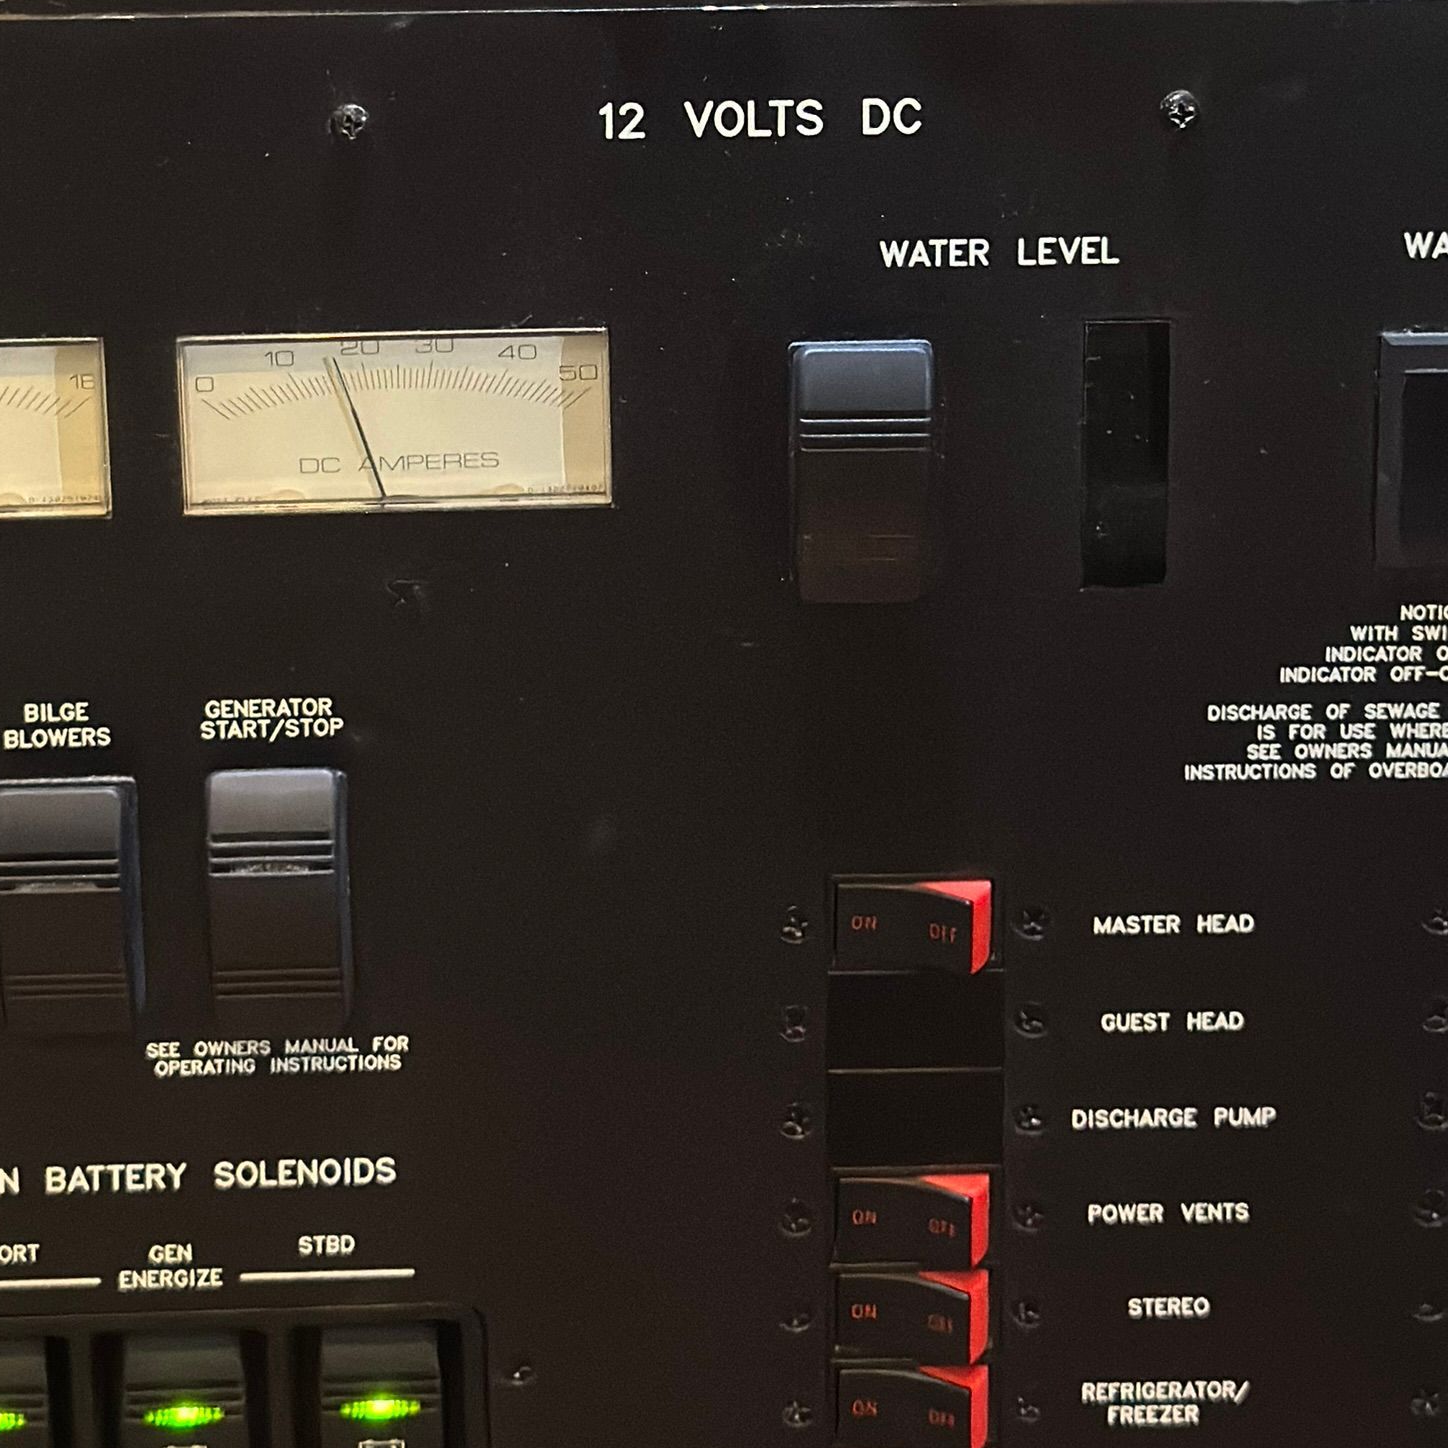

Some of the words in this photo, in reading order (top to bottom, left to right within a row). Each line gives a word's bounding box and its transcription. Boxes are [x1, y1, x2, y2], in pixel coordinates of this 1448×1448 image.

[599, 102, 645, 139] 12
[684, 99, 823, 137] VOLTS
[863, 98, 921, 135] DC
[880, 239, 989, 267] WATER
[1018, 236, 1120, 265] LEVEL
[299, 454, 340, 475] DC
[359, 451, 500, 472] AMPERES
[1350, 625, 1398, 641] WITH
[1326, 646, 1422, 662] INDICATOR
[1280, 666, 1376, 683] INDICATOR
[24, 702, 89, 722] BILGE
[205, 698, 332, 718] GENERATOR
[1208, 704, 1312, 721] DISCHARGE
[1326, 703, 1350, 720] OF
[1365, 702, 1440, 719] SEWAGE
[4, 727, 111, 749] BLOWERS
[200, 718, 344, 742] START/STOP
[1094, 915, 1180, 934] MASTER
[1197, 914, 1254, 933] HEAD
[1101, 1012, 1170, 1032] GUEST
[1187, 1011, 1244, 1031] HEAD
[146, 1042, 180, 1058] SEE
[194, 1040, 270, 1057] OWNERS
[285, 1037, 359, 1053] MANUAL
[373, 1035, 408, 1052] FOR
[154, 1058, 255, 1077] OPERATING
[271, 1054, 401, 1073] INSTRUCTIONS
[1072, 1108, 1197, 1129] DISCHARGE
[1215, 1107, 1276, 1126] PUMP
[46, 1163, 186, 1193] BATTERY
[214, 1157, 396, 1188] SOLENOIDS
[1088, 1203, 1163, 1223] POWER
[1181, 1203, 1249, 1222] VENTS
[149, 1244, 192, 1263] GEN
[299, 1235, 355, 1254] STBD
[119, 1268, 223, 1289] ENERGIZE
[1129, 1297, 1209, 1316] STEREO
[1082, 1381, 1248, 1402] REFRIGERATOR/
[1108, 1405, 1198, 1424] FREEZER
